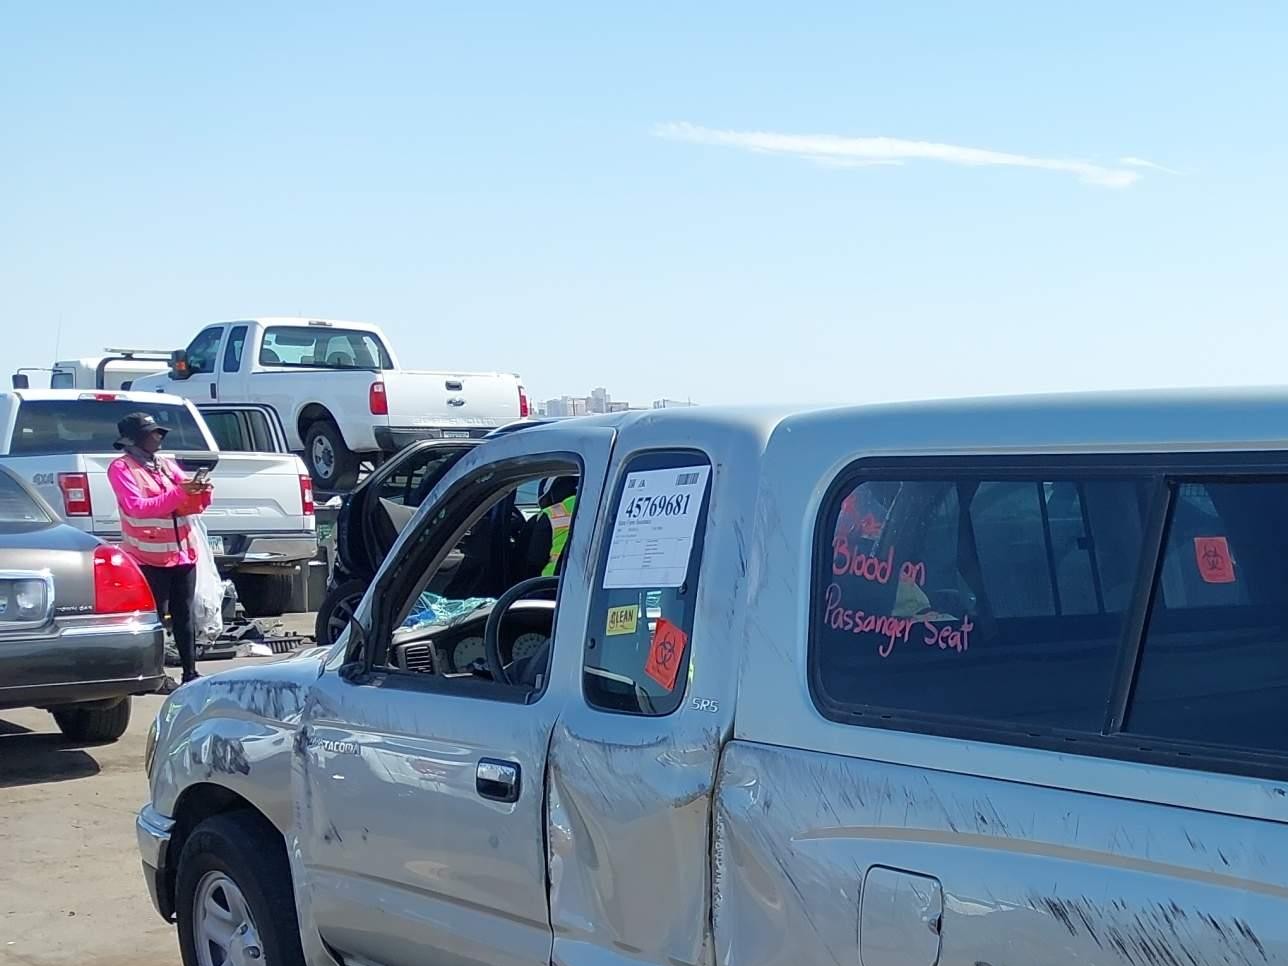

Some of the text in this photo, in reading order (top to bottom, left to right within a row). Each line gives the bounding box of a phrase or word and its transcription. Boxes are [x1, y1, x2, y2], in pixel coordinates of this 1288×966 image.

[625, 493, 691, 518] 45769681
[832, 535, 926, 586] Blood on
[924, 612, 974, 652] Seat
